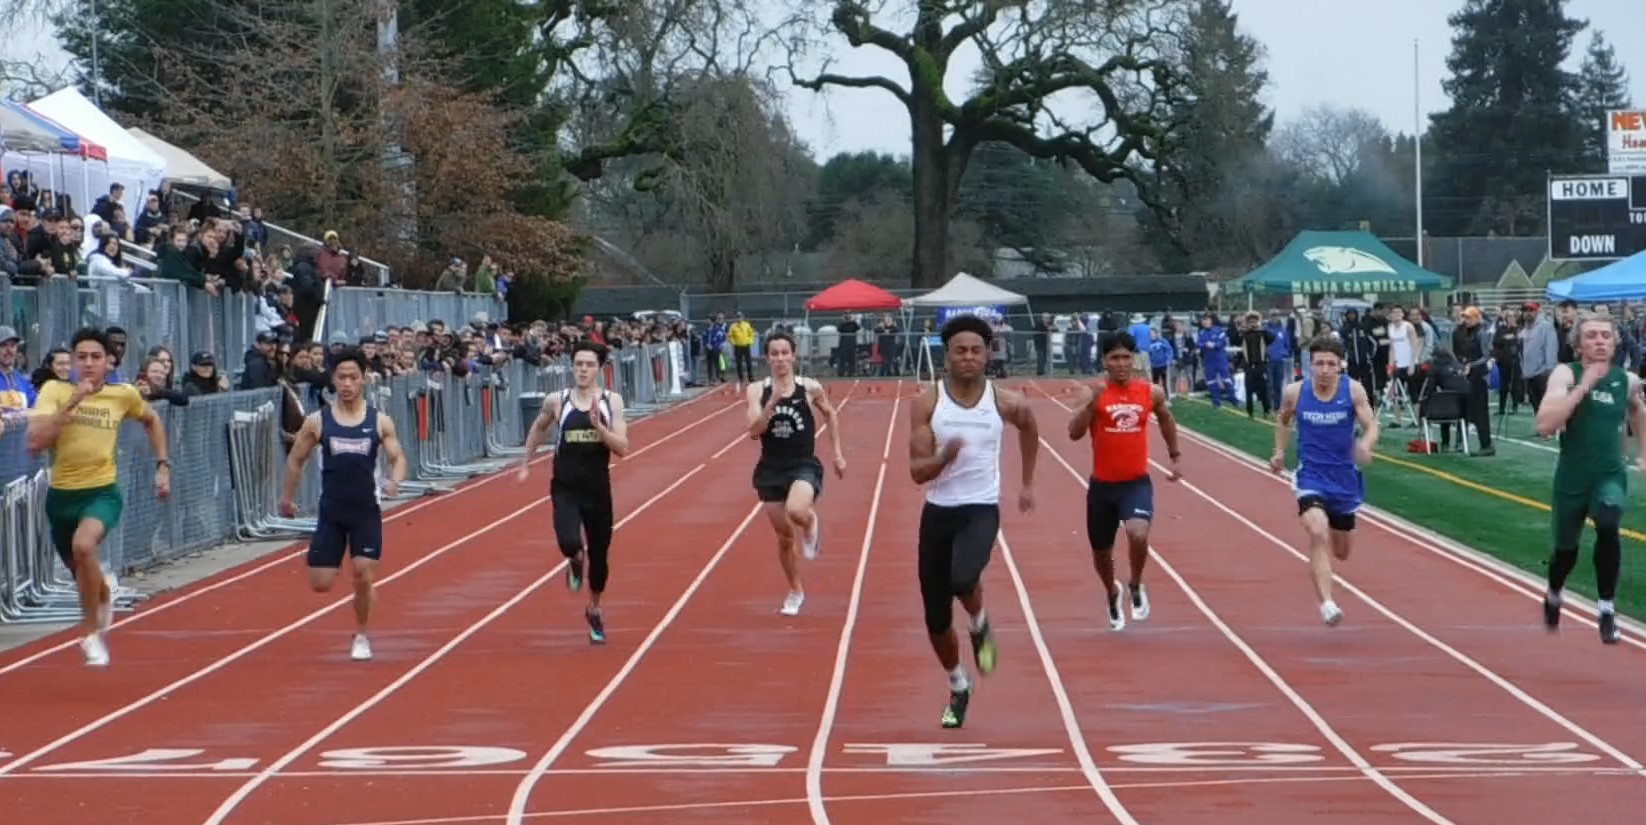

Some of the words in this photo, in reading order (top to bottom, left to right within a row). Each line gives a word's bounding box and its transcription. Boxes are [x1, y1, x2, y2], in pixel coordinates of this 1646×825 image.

[1562, 182, 1617, 197] HOME
[1570, 235, 1615, 253] DOWN
[1291, 280, 1338, 293] MARIA
[1343, 280, 1417, 293] CARRILLO
[30, 748, 260, 770] 7
[317, 745, 527, 768] 6
[584, 743, 798, 767] 5
[842, 742, 1064, 765] 4
[1105, 742, 1326, 764] 3
